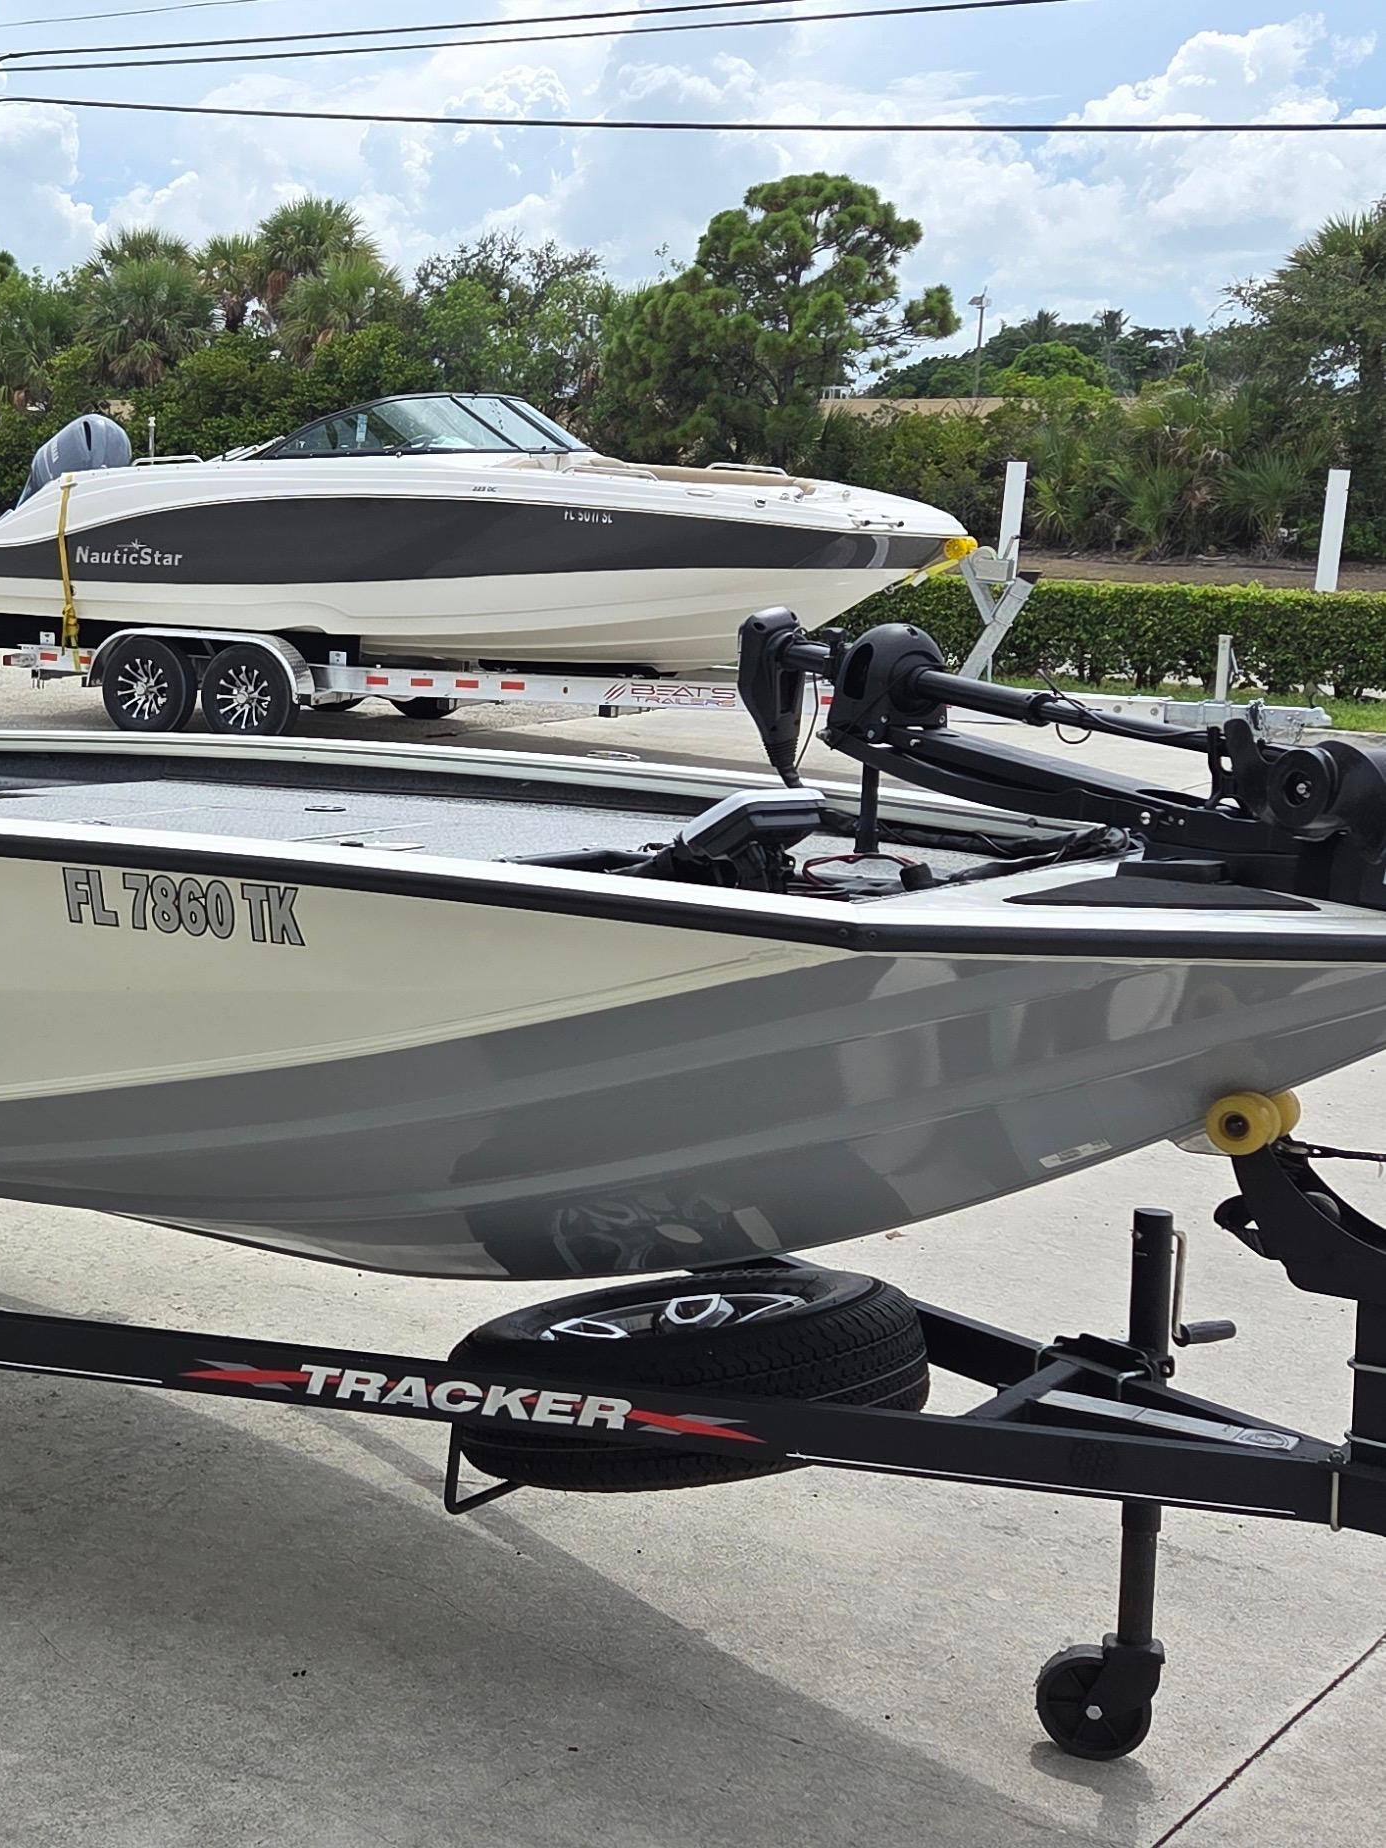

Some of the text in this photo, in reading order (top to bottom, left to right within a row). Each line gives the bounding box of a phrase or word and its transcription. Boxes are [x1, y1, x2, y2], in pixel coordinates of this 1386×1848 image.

[75, 545, 183, 567] NauticStar
[630, 682, 737, 699] BEATS
[635, 695, 736, 707] TRAILERS
[62, 866, 306, 947] FL 7860 TK
[299, 1364, 632, 1430] TRACKER
